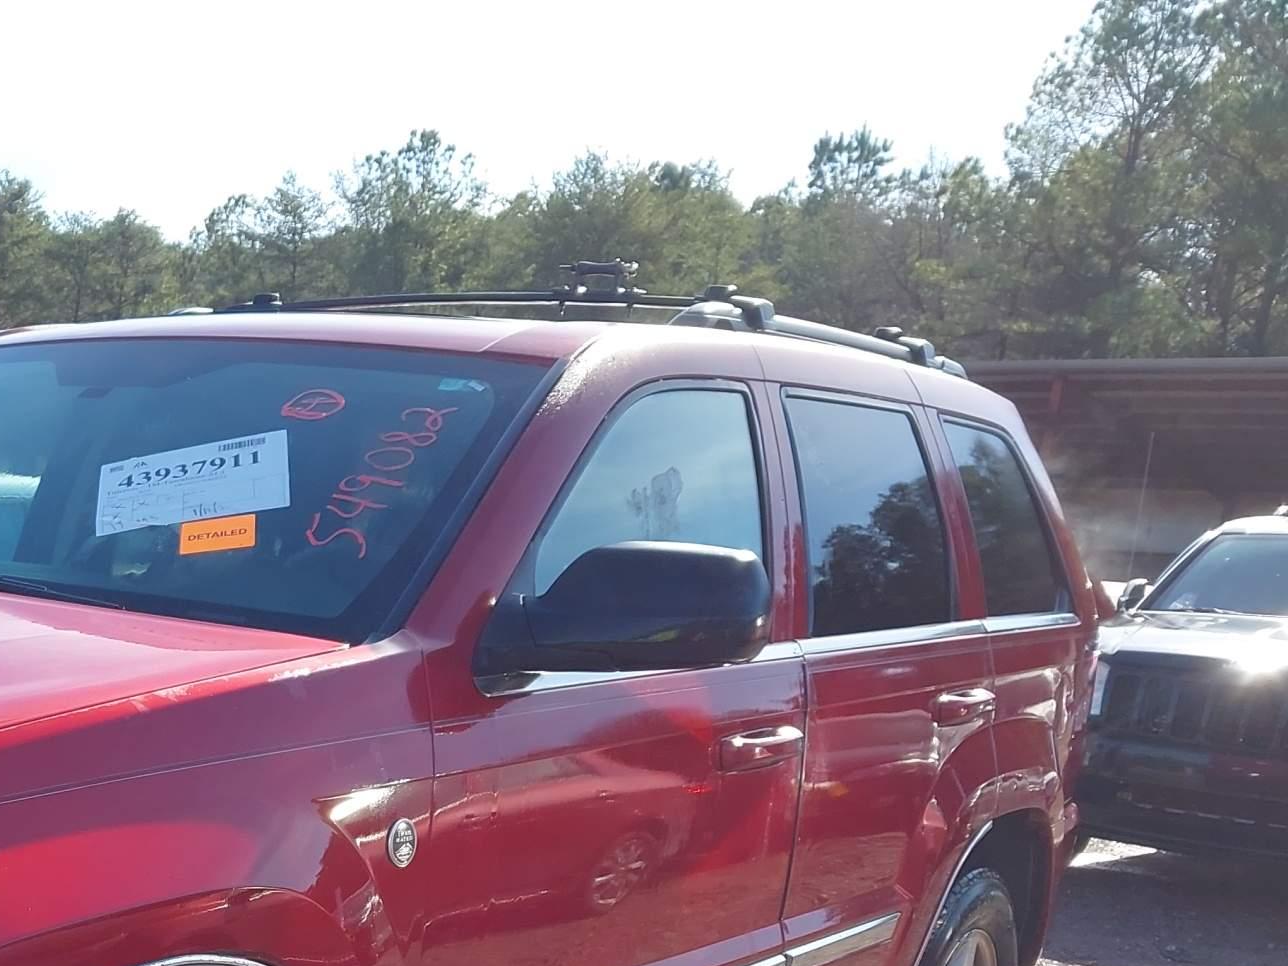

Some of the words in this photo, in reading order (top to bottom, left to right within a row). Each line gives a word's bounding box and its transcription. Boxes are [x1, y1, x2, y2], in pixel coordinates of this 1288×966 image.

[117, 450, 261, 489] 43937911
[306, 406, 459, 560] 549082
[187, 528, 248, 542] DETAILED
